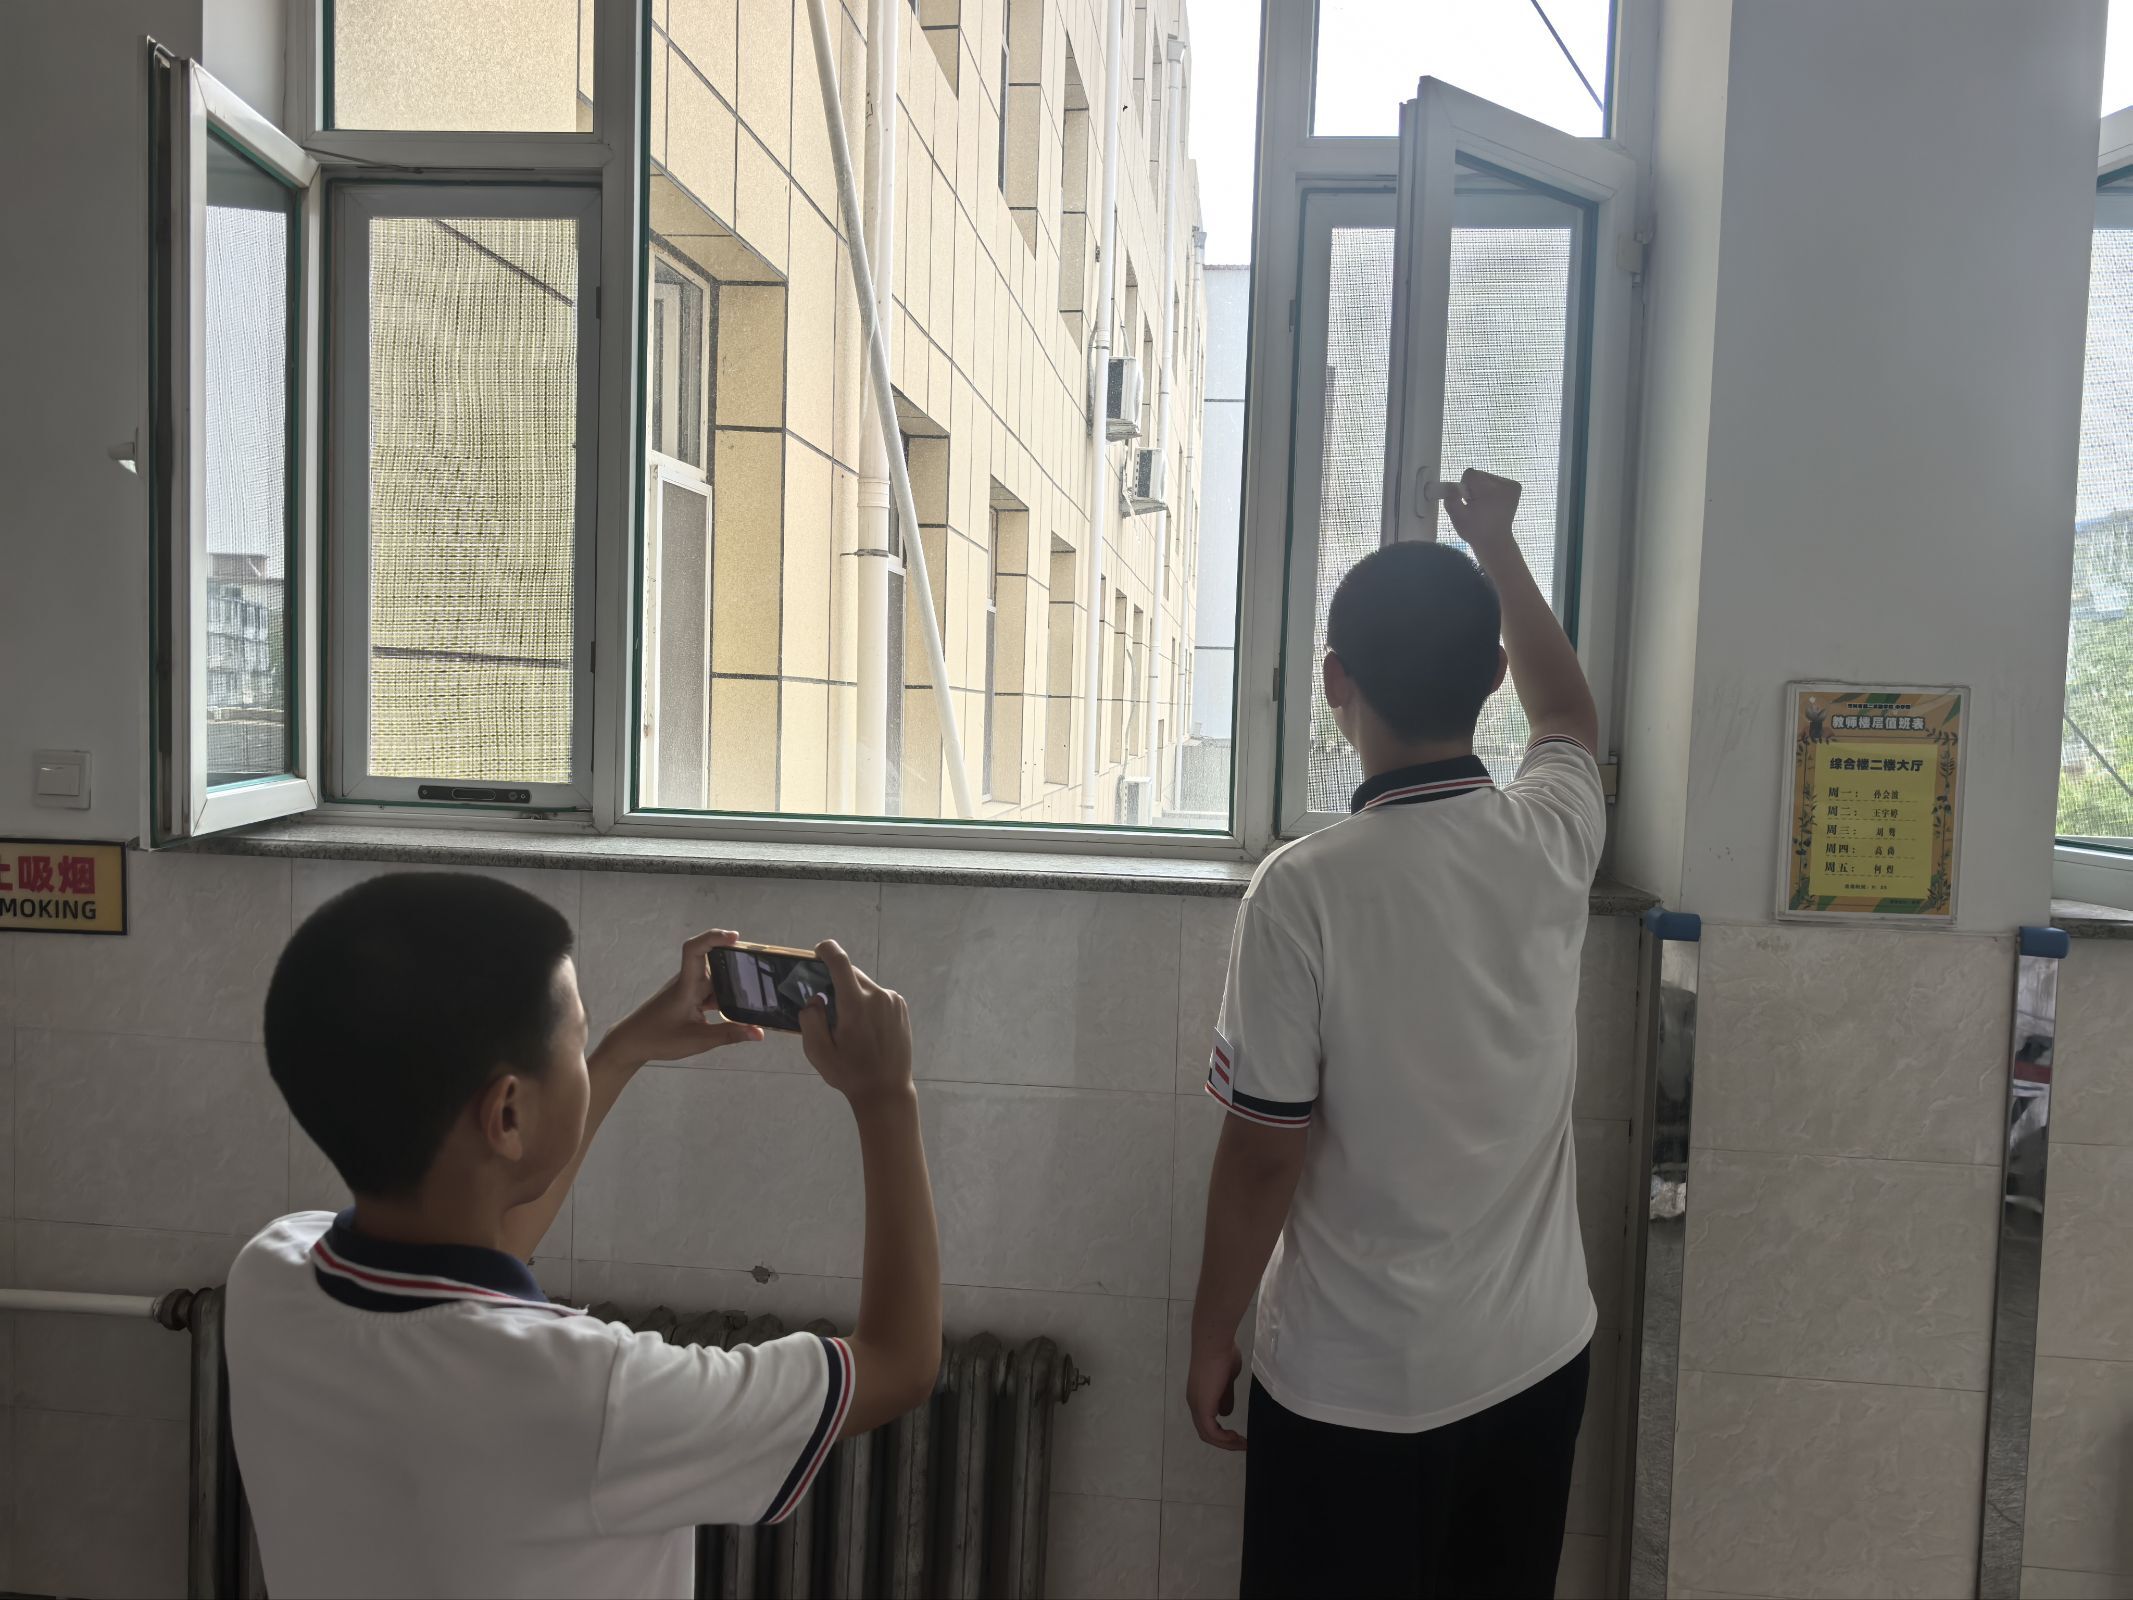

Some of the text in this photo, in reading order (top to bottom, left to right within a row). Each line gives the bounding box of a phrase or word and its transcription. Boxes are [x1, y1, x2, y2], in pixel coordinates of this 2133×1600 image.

[1832, 715, 1925, 730] 教师楼层值班表
[1829, 757, 1924, 772] 综合楼二楼大厅
